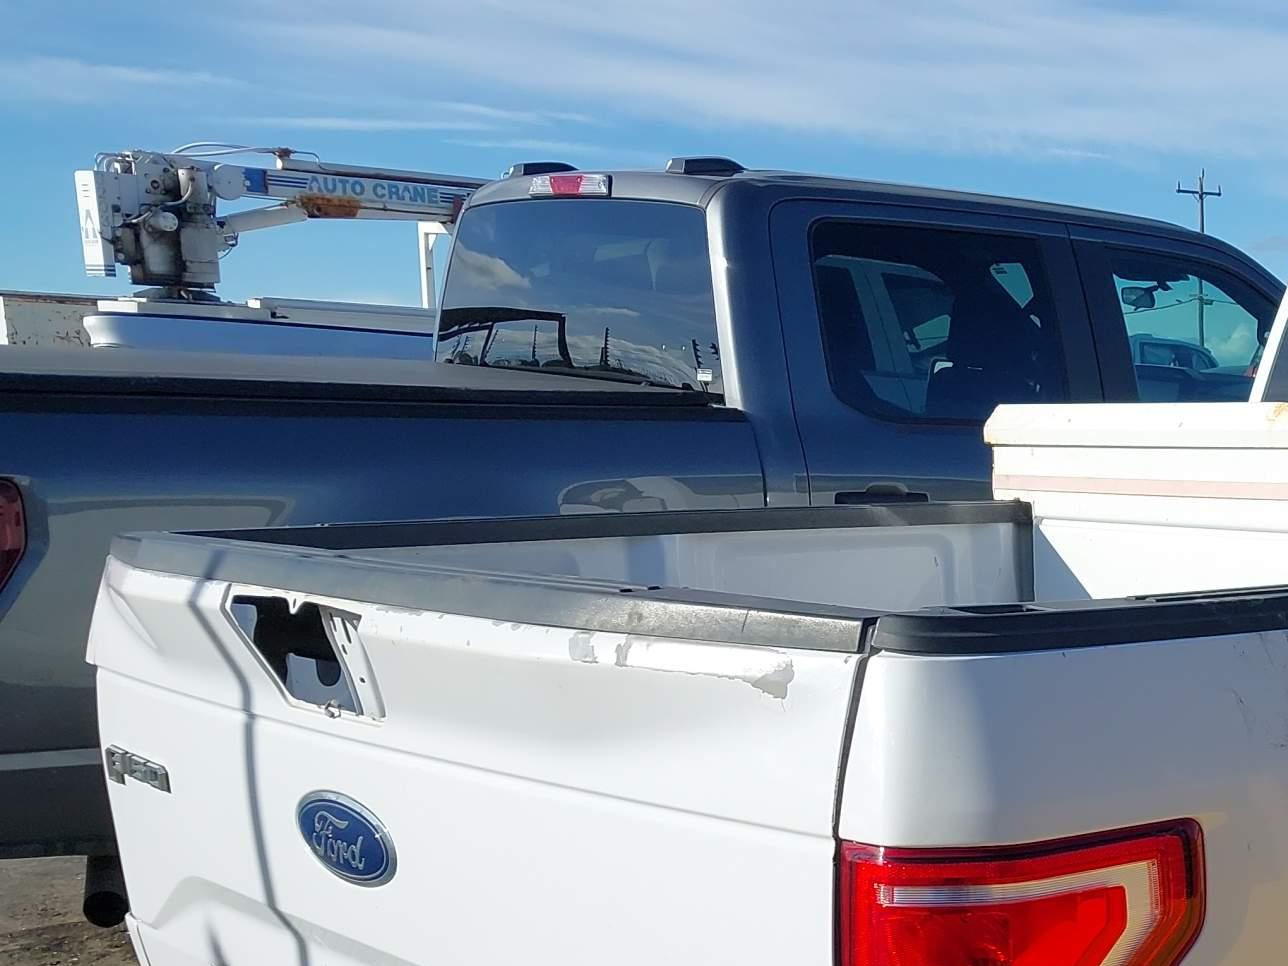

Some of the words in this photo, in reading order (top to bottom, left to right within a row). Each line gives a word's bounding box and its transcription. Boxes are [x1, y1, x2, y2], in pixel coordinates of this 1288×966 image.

[307, 175, 366, 196] AUTO
[372, 182, 440, 204] CRANE
[312, 810, 366, 870] Ford
